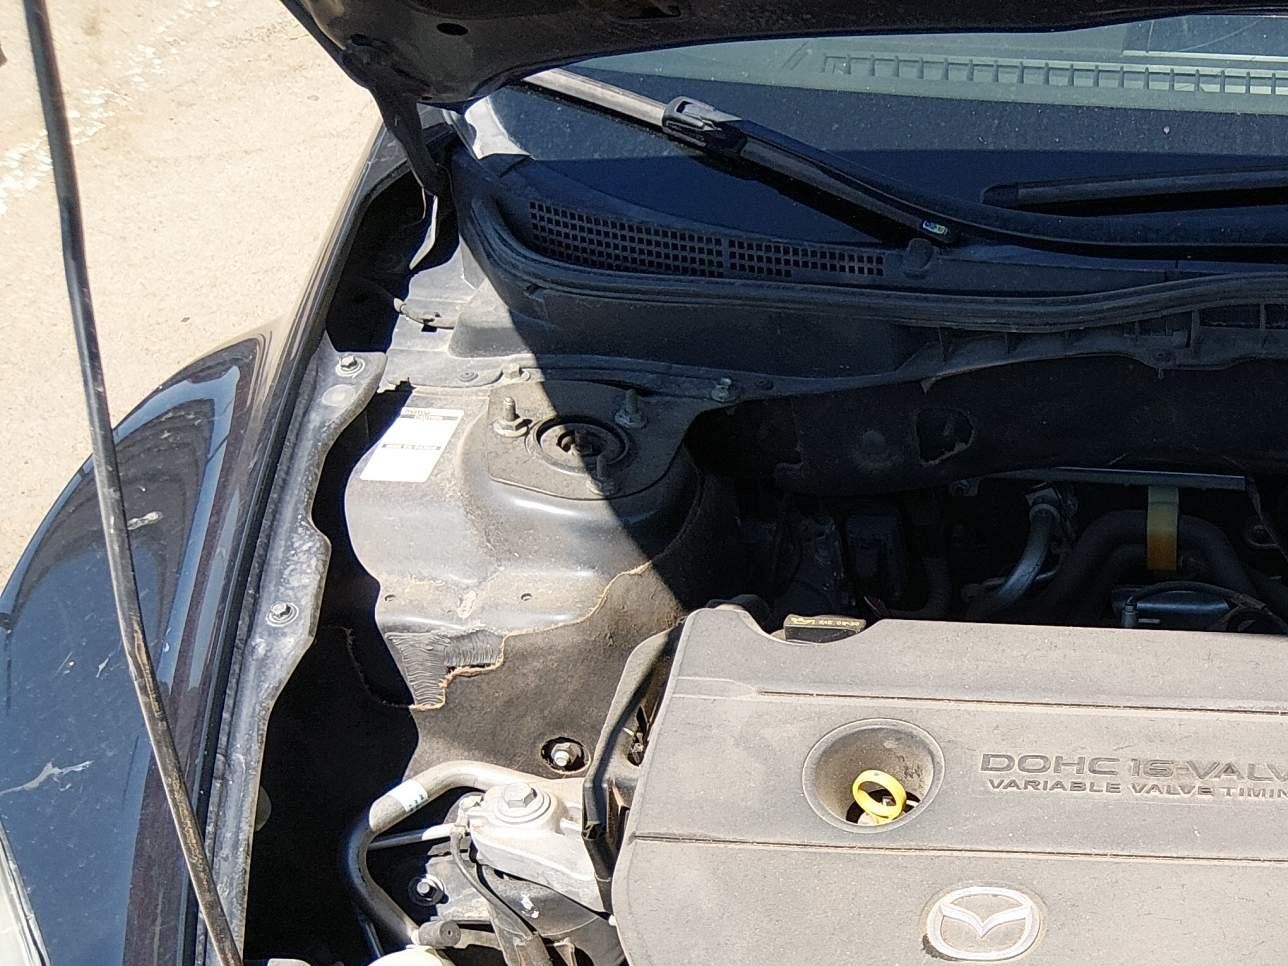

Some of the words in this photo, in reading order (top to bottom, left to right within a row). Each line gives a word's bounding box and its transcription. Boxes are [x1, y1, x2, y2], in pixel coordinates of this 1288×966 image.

[980, 753, 1120, 776] DOHC
[988, 777, 1121, 796] VARIABLE
[1131, 782, 1213, 798] VALVE
